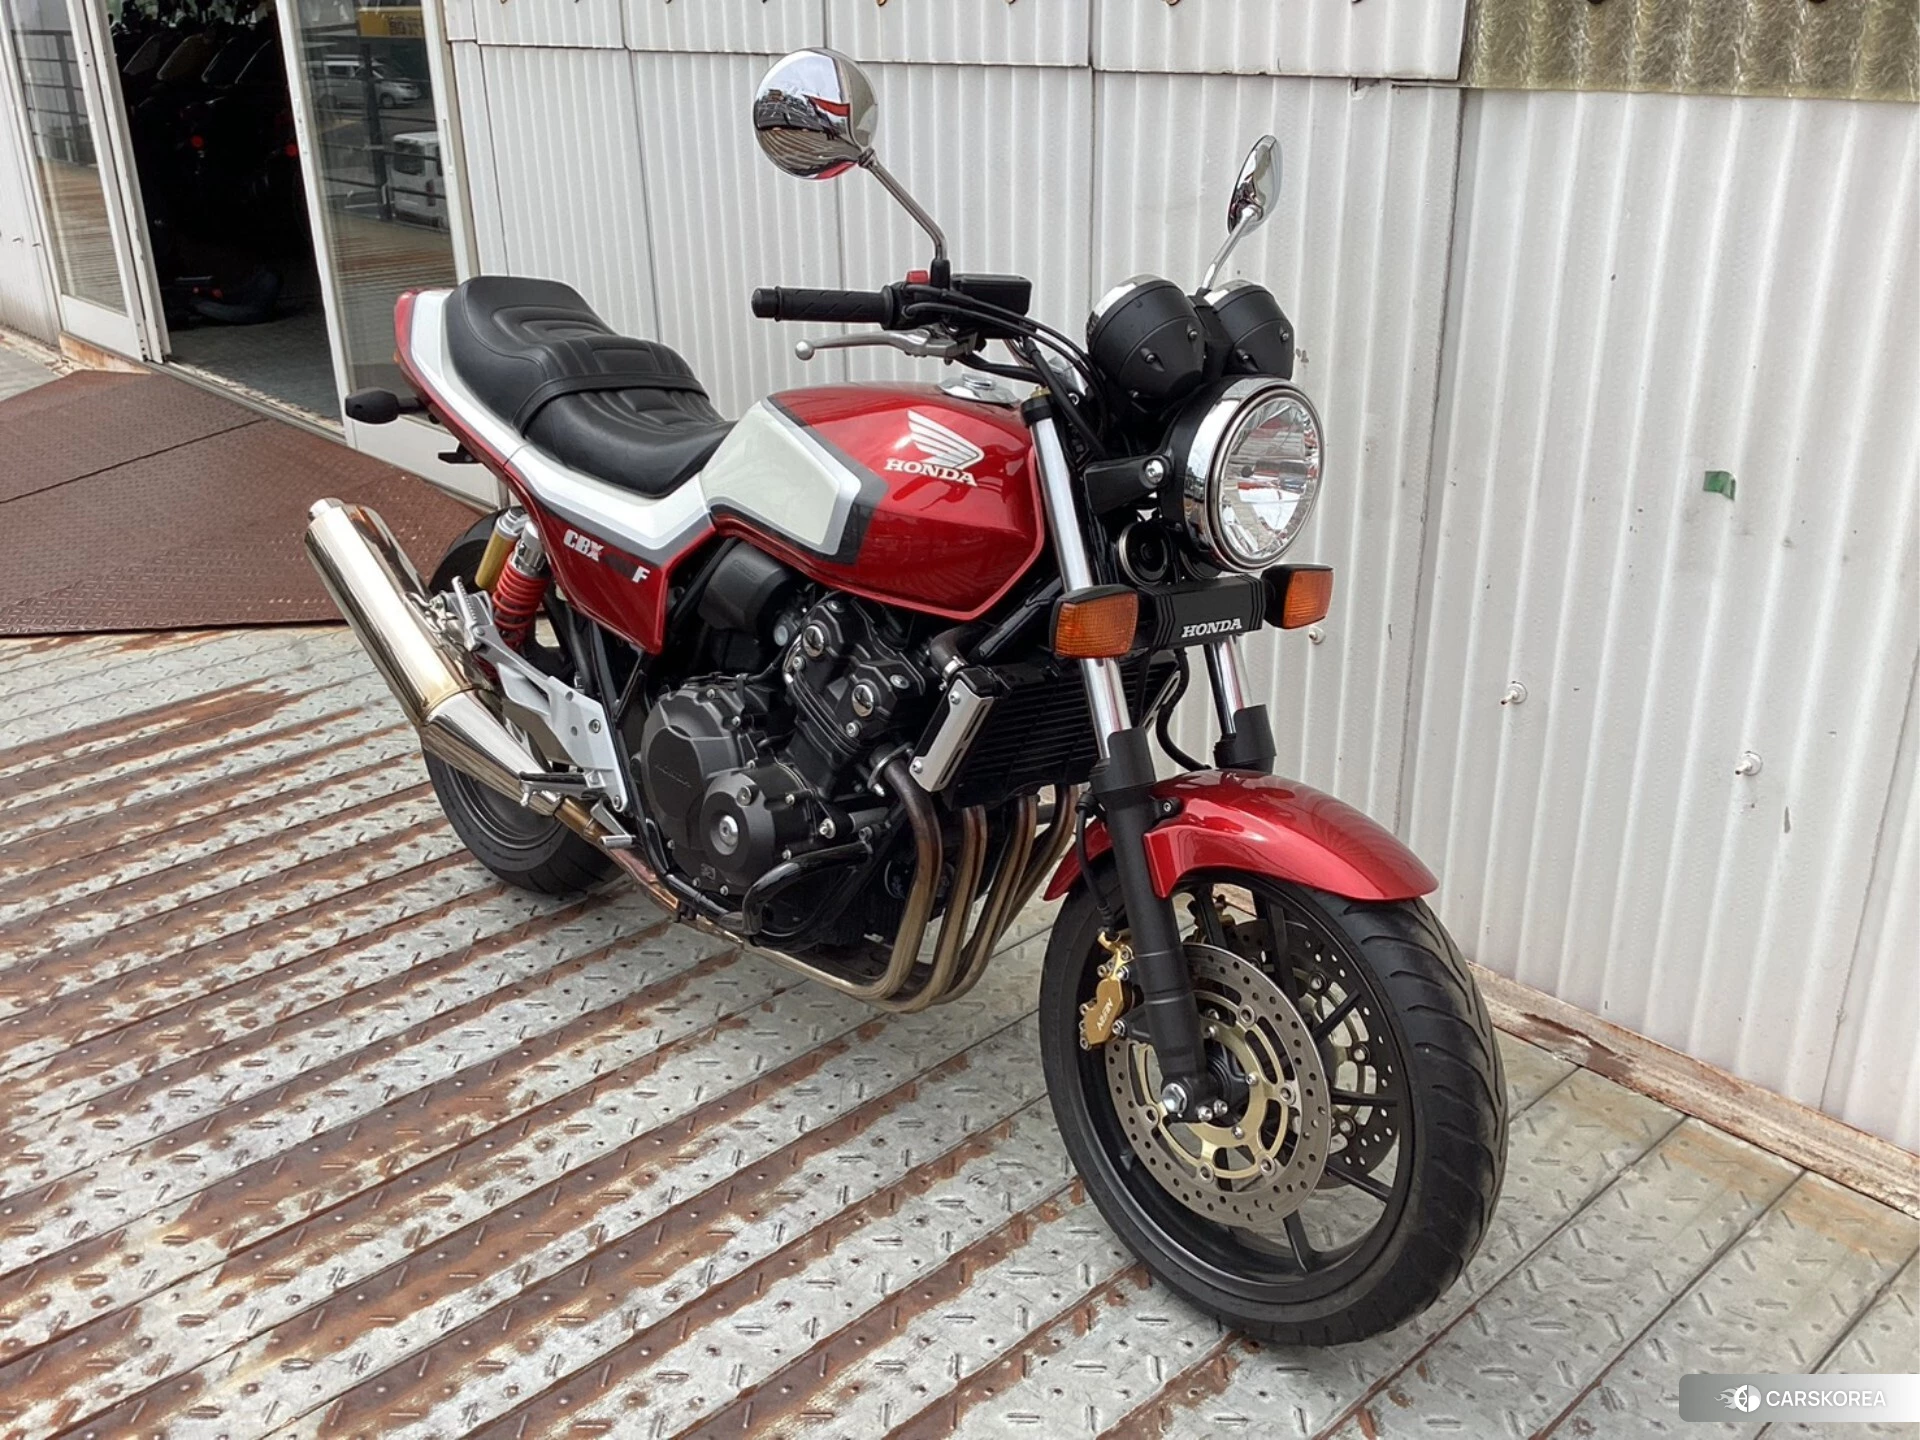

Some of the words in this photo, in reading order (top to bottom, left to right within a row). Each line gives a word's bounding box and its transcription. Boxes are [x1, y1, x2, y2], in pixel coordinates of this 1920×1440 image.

[883, 458, 978, 487] HONDA
[563, 529, 604, 562] CBX
[632, 565, 651, 583] F
[1181, 618, 1242, 638] HONDA
